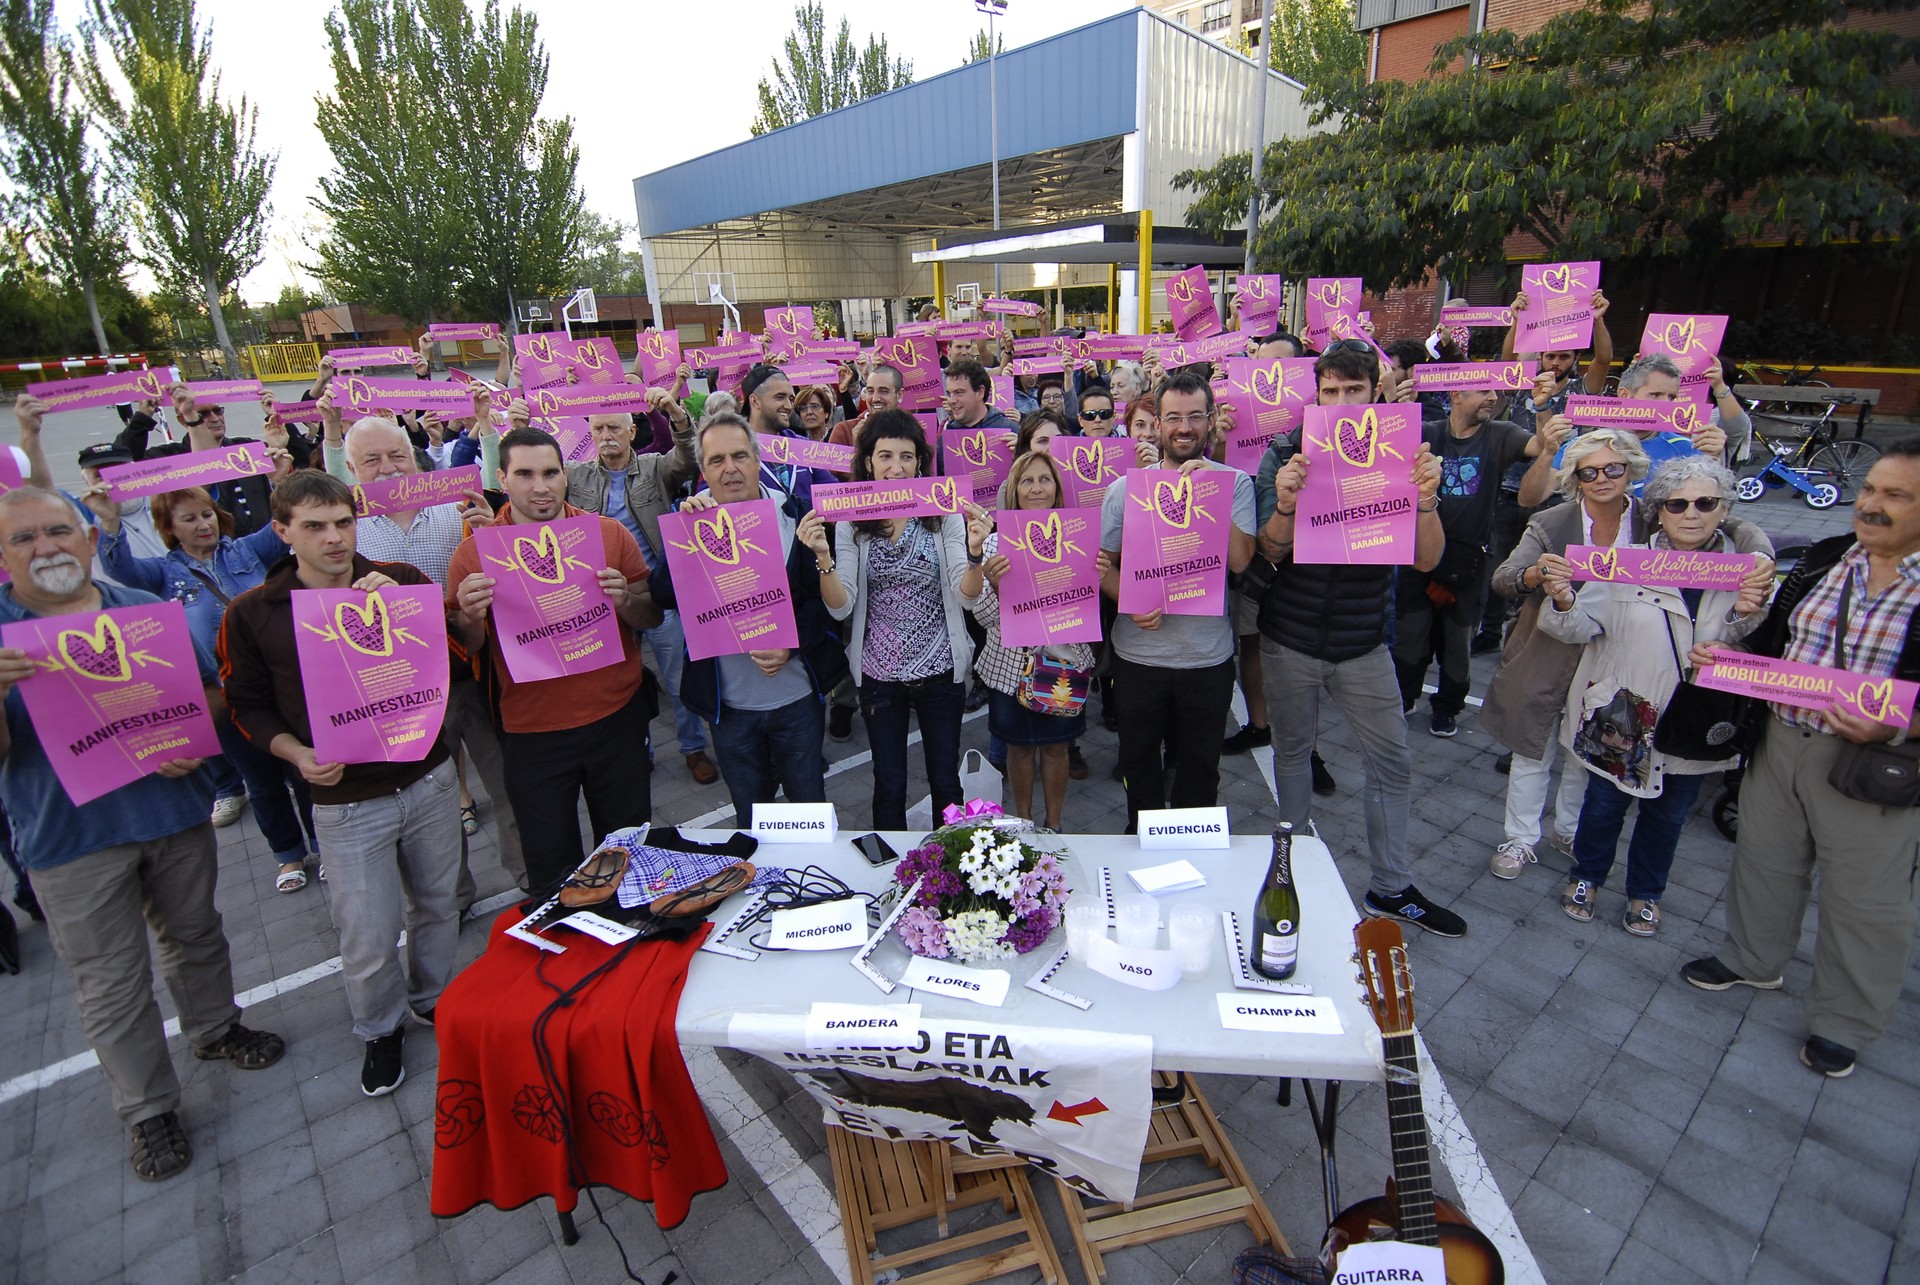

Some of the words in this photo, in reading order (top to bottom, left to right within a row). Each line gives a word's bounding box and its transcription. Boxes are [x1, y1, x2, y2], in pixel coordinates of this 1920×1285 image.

[1445, 312, 1492, 321] MOBILIZAZIOA!
[1526, 311, 1591, 331] MANIFESTAZIOA
[940, 326, 979, 336] MOBILIZAZIOA!
[1420, 370, 1489, 384] MOBILIZAZIOA!
[377, 389, 466, 398] obedientzia-ekitaldia
[562, 391, 640, 407] obedientzia-ekitaldia
[1573, 406, 1656, 418] MOBILIZAZIOA!
[118, 460, 224, 492] obedientzia-ekitaldia
[389, 473, 476, 501] elkartasuna
[815, 489, 834, 497] irailak
[845, 484, 873, 494] Barañain
[822, 488, 913, 512] MOBILIZAZIOA!
[855, 501, 918, 516] obedientzia-ekitaldia
[1310, 497, 1411, 527] MANIFESTAZIOA
[1351, 535, 1393, 550] BARAÑAIN
[1134, 555, 1222, 582] MANIFESTAZIOA
[1640, 551, 1748, 575] elkartasuna
[1012, 585, 1095, 615] MANIFESTAZIOA
[1169, 588, 1206, 602] BARAÑAIN
[696, 588, 785, 625] MANIFESTAZIOA
[515, 602, 610, 646] MANIFESTAZIOA
[740, 623, 777, 641] BARAÑAIN
[1049, 617, 1083, 634] BARAÑAIN
[564, 640, 604, 662] BARAÑAIN
[1713, 655, 1741, 665] atorren
[1742, 659, 1770, 668] astean
[1712, 664, 1833, 693] MOBILIZAZIOA!
[1750, 685, 1835, 703] obedientzia-ekitaldia
[329, 687, 443, 727] MANIFESTAZIOA
[69, 702, 202, 757] MANIFESTAZIOA
[387, 729, 426, 746] BARAÑAIN
[135, 737, 190, 760] BARAÑAIN
[758, 819, 826, 831] EVIDENCIAS
[1148, 823, 1222, 836] EVIDENCIAS
[1399, 903, 1426, 920] N
[597, 923, 626, 937] BAILE
[785, 921, 853, 940] MICRÓFONO
[1119, 962, 1153, 976] VASO
[926, 975, 981, 992] FLORES
[1236, 1005, 1317, 1018] CHAMPÁN
[825, 1018, 899, 1029] BANDERA
[945, 1031, 1014, 1061] ETA
[1336, 1268, 1424, 1285] GUITARRA
